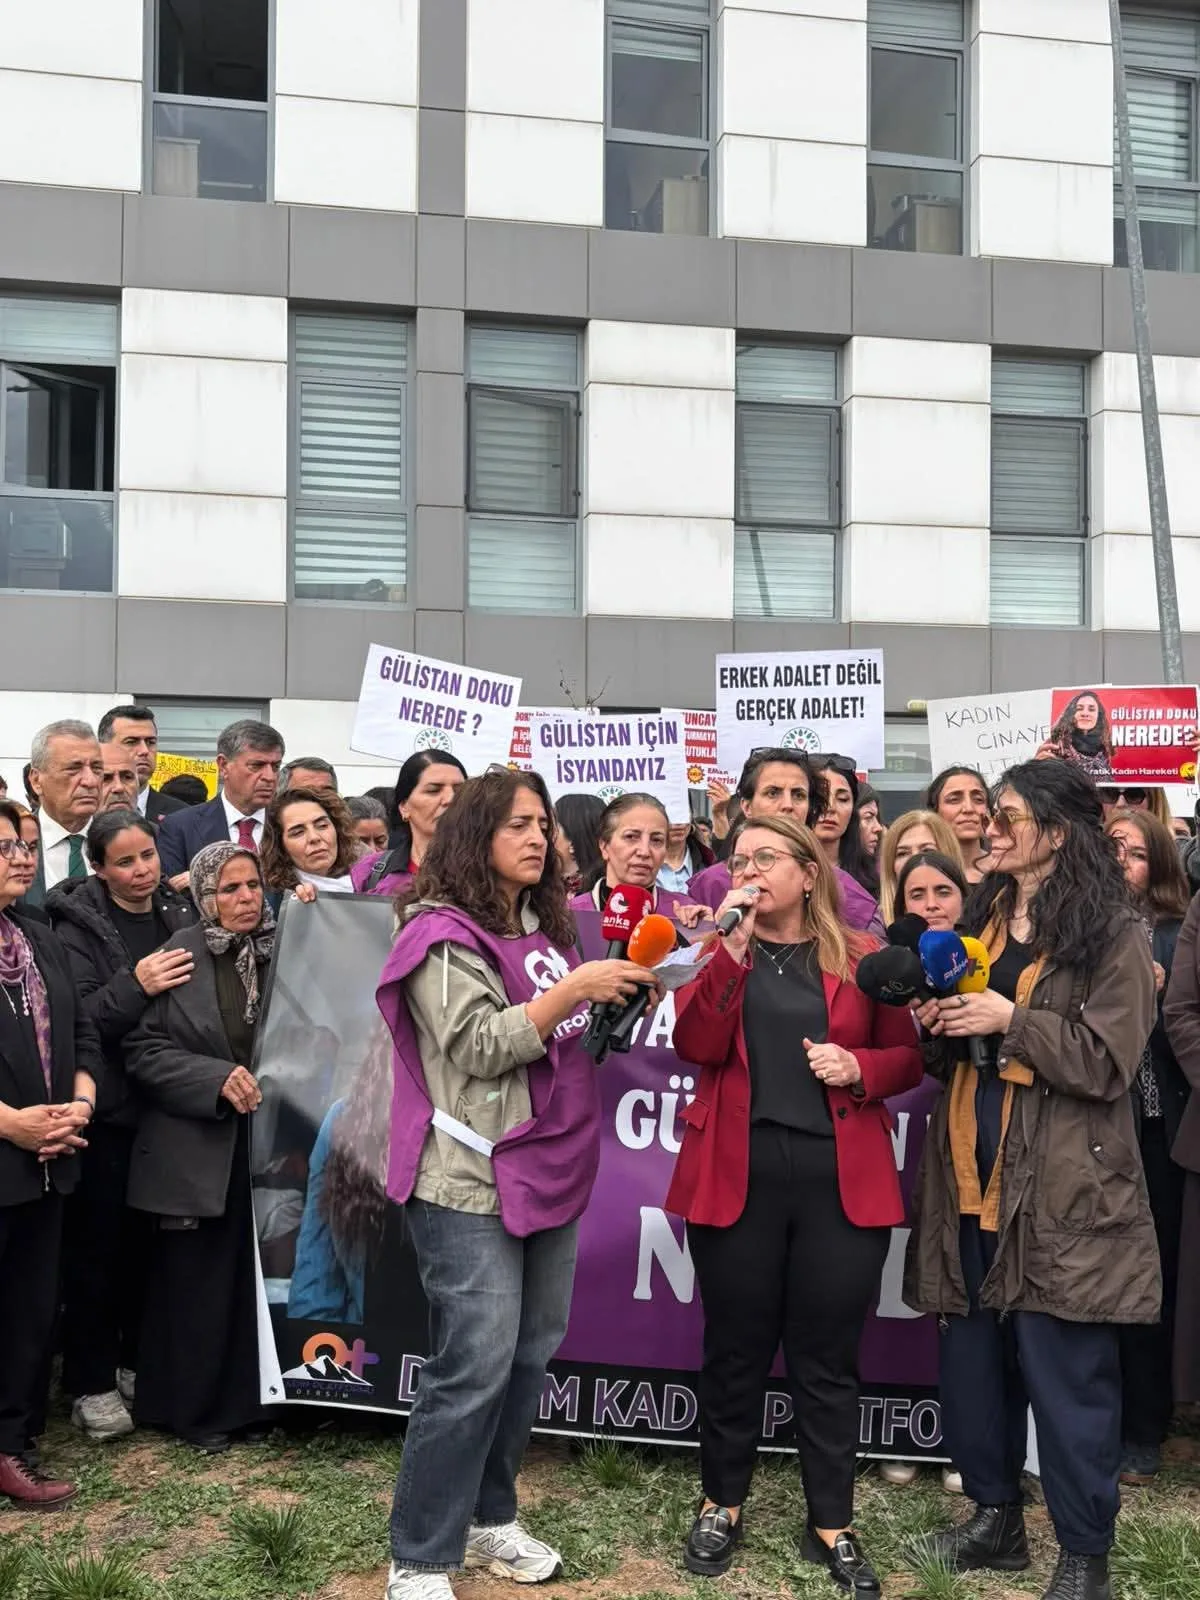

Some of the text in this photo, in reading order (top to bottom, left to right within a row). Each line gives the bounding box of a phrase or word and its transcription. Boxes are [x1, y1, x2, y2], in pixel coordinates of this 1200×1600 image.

[380, 654, 514, 708] GÜLİSTAN DOKU
[720, 659, 881, 689] ERKEK ADALET DEĞİL
[398, 696, 483, 736] NEREDE ?
[683, 712, 717, 727] UNCAY
[736, 696, 864, 727] GERÇEK ADALET!
[945, 702, 1011, 728] KADIN
[1111, 706, 1197, 721] GÜLİSTAN DOKU
[540, 717, 678, 752] GÜLİSTAN İÇİN
[977, 724, 1051, 750] CİNAYE
[1111, 724, 1196, 747] NEREDE?
[556, 753, 666, 784] İSYANDAYIZ
[1089, 767, 1179, 776] ratik Kadın Hareketi
